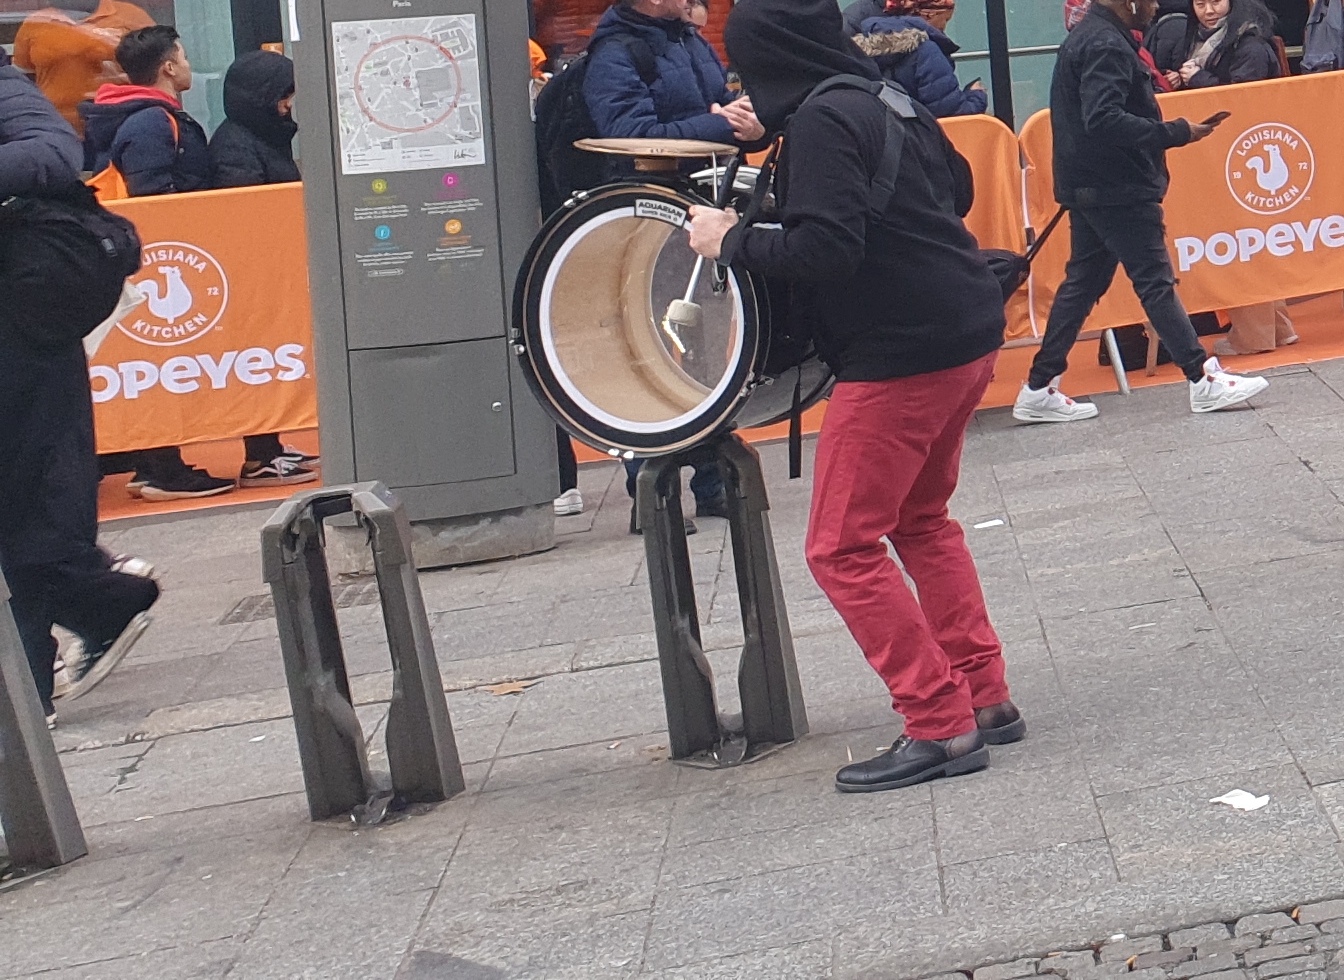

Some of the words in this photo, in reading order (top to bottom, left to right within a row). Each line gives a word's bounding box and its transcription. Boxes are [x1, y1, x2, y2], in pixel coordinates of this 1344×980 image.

[1236, 129, 1299, 157] LOUISIANA
[1245, 185, 1300, 207] KITCHEN
[638, 201, 683, 218] AQUARIAN
[143, 249, 208, 273] UISIANA
[206, 286, 220, 296] 72
[132, 312, 208, 339] KITCHEN
